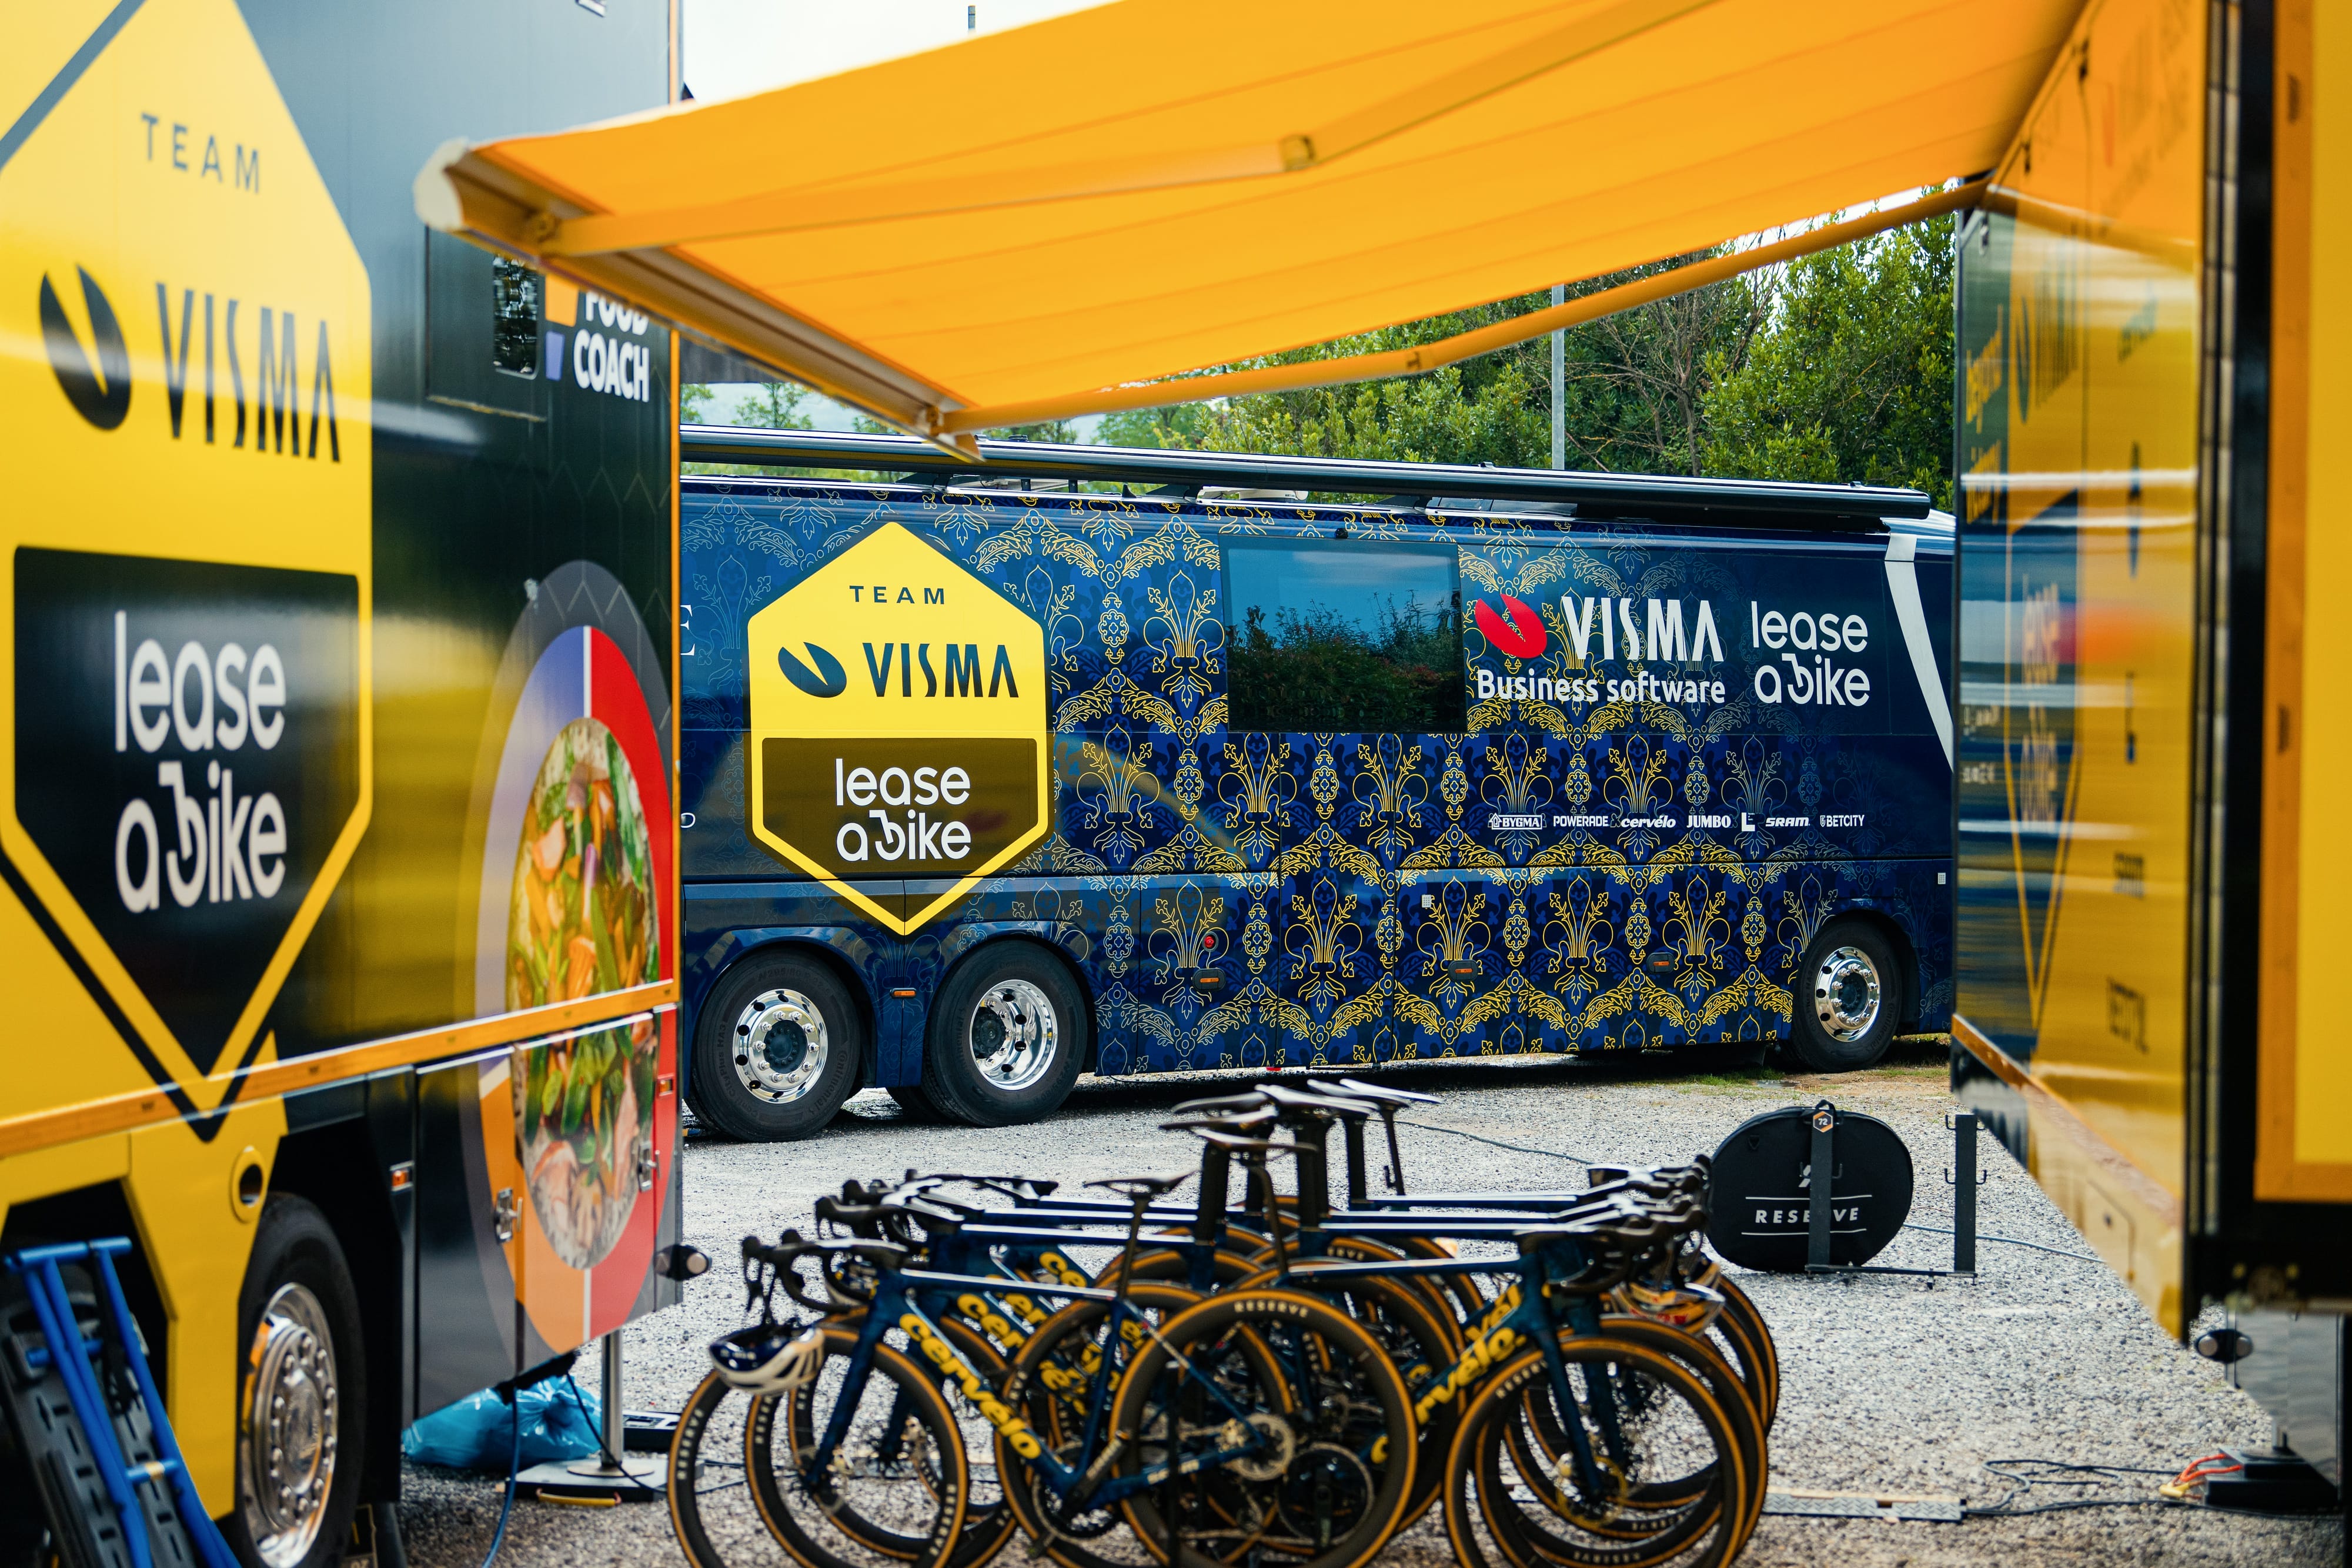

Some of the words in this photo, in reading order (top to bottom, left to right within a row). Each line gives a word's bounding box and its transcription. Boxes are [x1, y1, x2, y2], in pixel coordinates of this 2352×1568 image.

[141, 112, 260, 194] TEAM
[156, 282, 341, 464] VISMA
[574, 329, 649, 403] COACH
[849, 585, 945, 605] TEAM
[1561, 596, 1724, 662] VISMA
[1751, 600, 1868, 651] lease
[114, 610, 286, 753] lease
[863, 643, 1019, 698] VISMA
[1478, 670, 1598, 702] Business
[1607, 670, 1726, 704] software
[836, 758, 970, 806] lease
[1502, 817, 1541, 828] BYGMA
[1553, 815, 1610, 827] POWERADE
[1621, 815, 1676, 828] cervélo
[1686, 815, 1732, 828] JUMBO
[1765, 817, 1809, 827] SRAM
[1826, 815, 1865, 827] BETCITY
[1755, 1207, 1859, 1223] RESEVE
